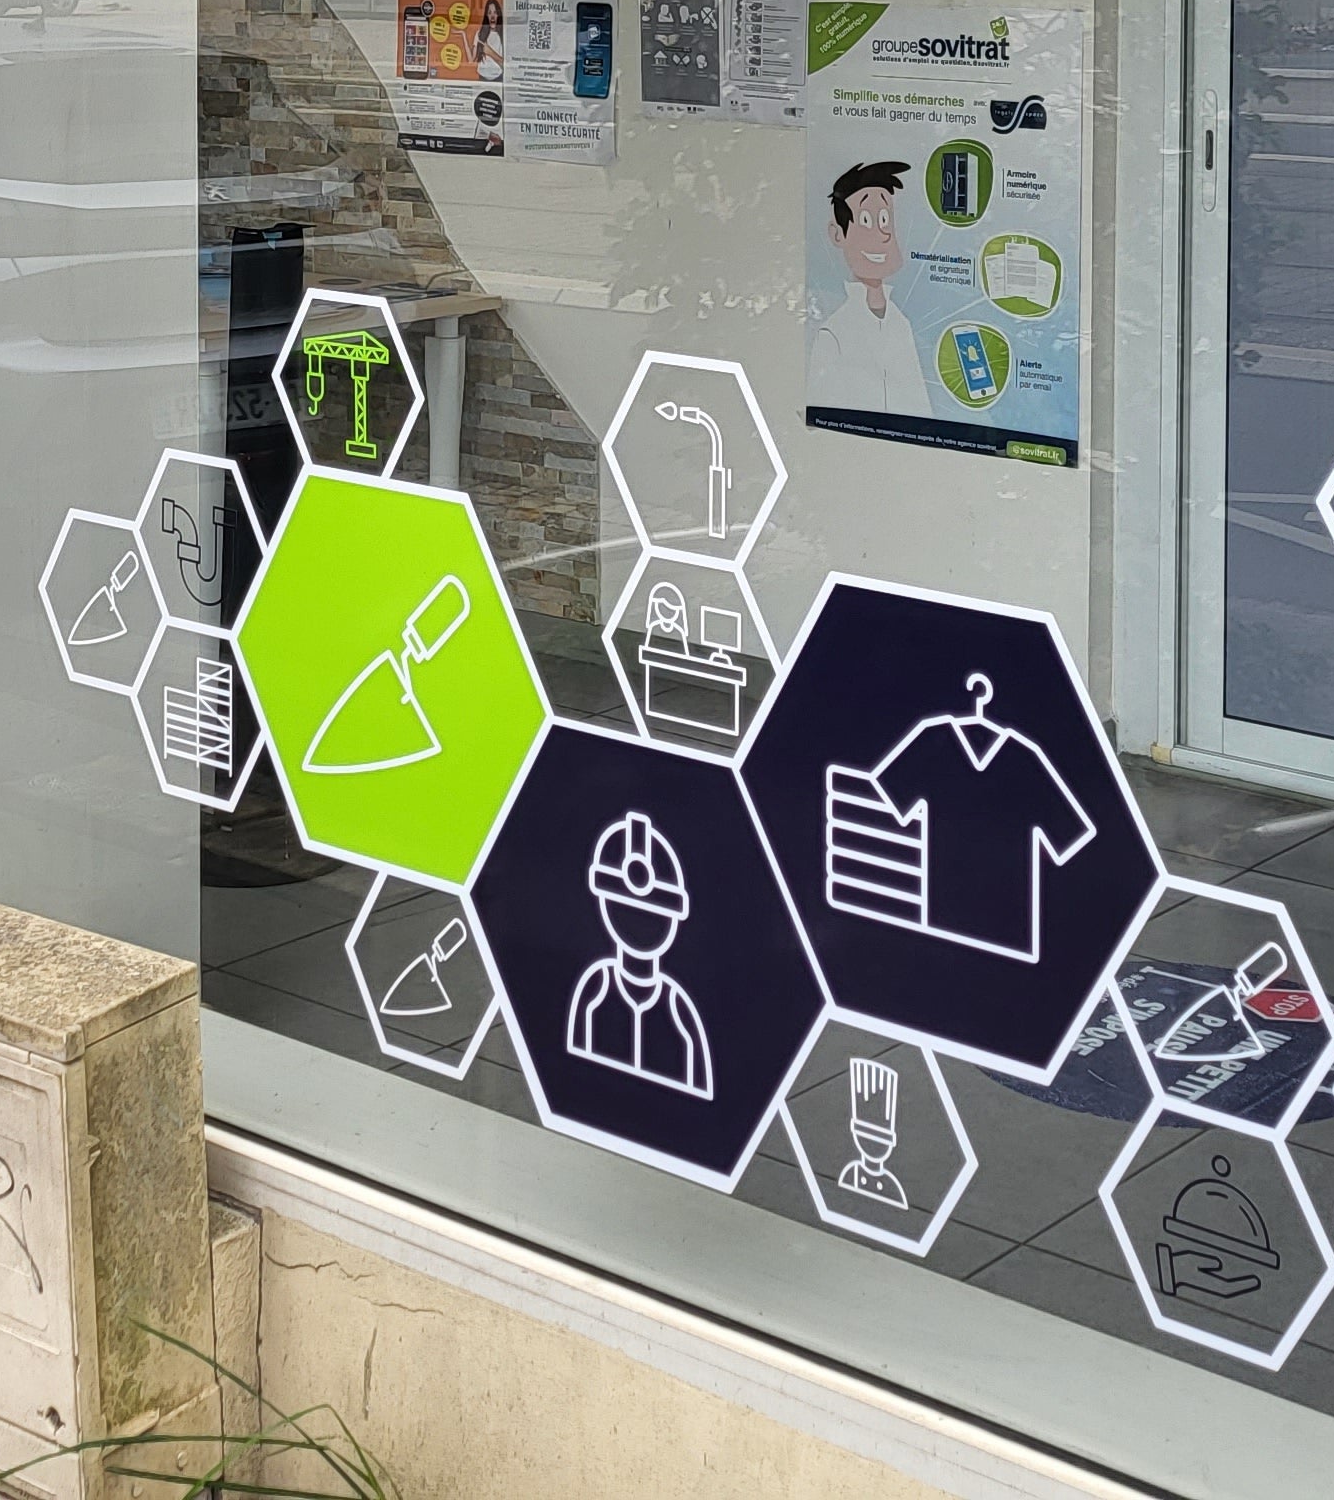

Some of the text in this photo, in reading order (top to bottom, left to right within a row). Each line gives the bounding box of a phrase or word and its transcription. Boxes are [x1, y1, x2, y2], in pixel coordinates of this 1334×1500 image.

[833, 88, 879, 104] Simplifie
[881, 93, 902, 104] vos
[904, 92, 965, 108] démarches
[536, 110, 578, 124] CONNECTÉ
[832, 106, 977, 126] et vous fait gagner du temps
[520, 123, 601, 141] EN TOUTE SÉCURITÉ
[1007, 169, 1037, 180] Armoire
[1006, 178, 1047, 191] numérique
[1006, 190, 1041, 200] sécurisée
[910, 251, 972, 265] Dématérialisation
[937, 264, 970, 276] signature
[929, 273, 972, 286] électronique
[1019, 359, 1043, 370] Alerte
[1019, 370, 1063, 383] automatique
[1019, 380, 1052, 391] par email
[1273, 994, 1309, 1016] STOP
